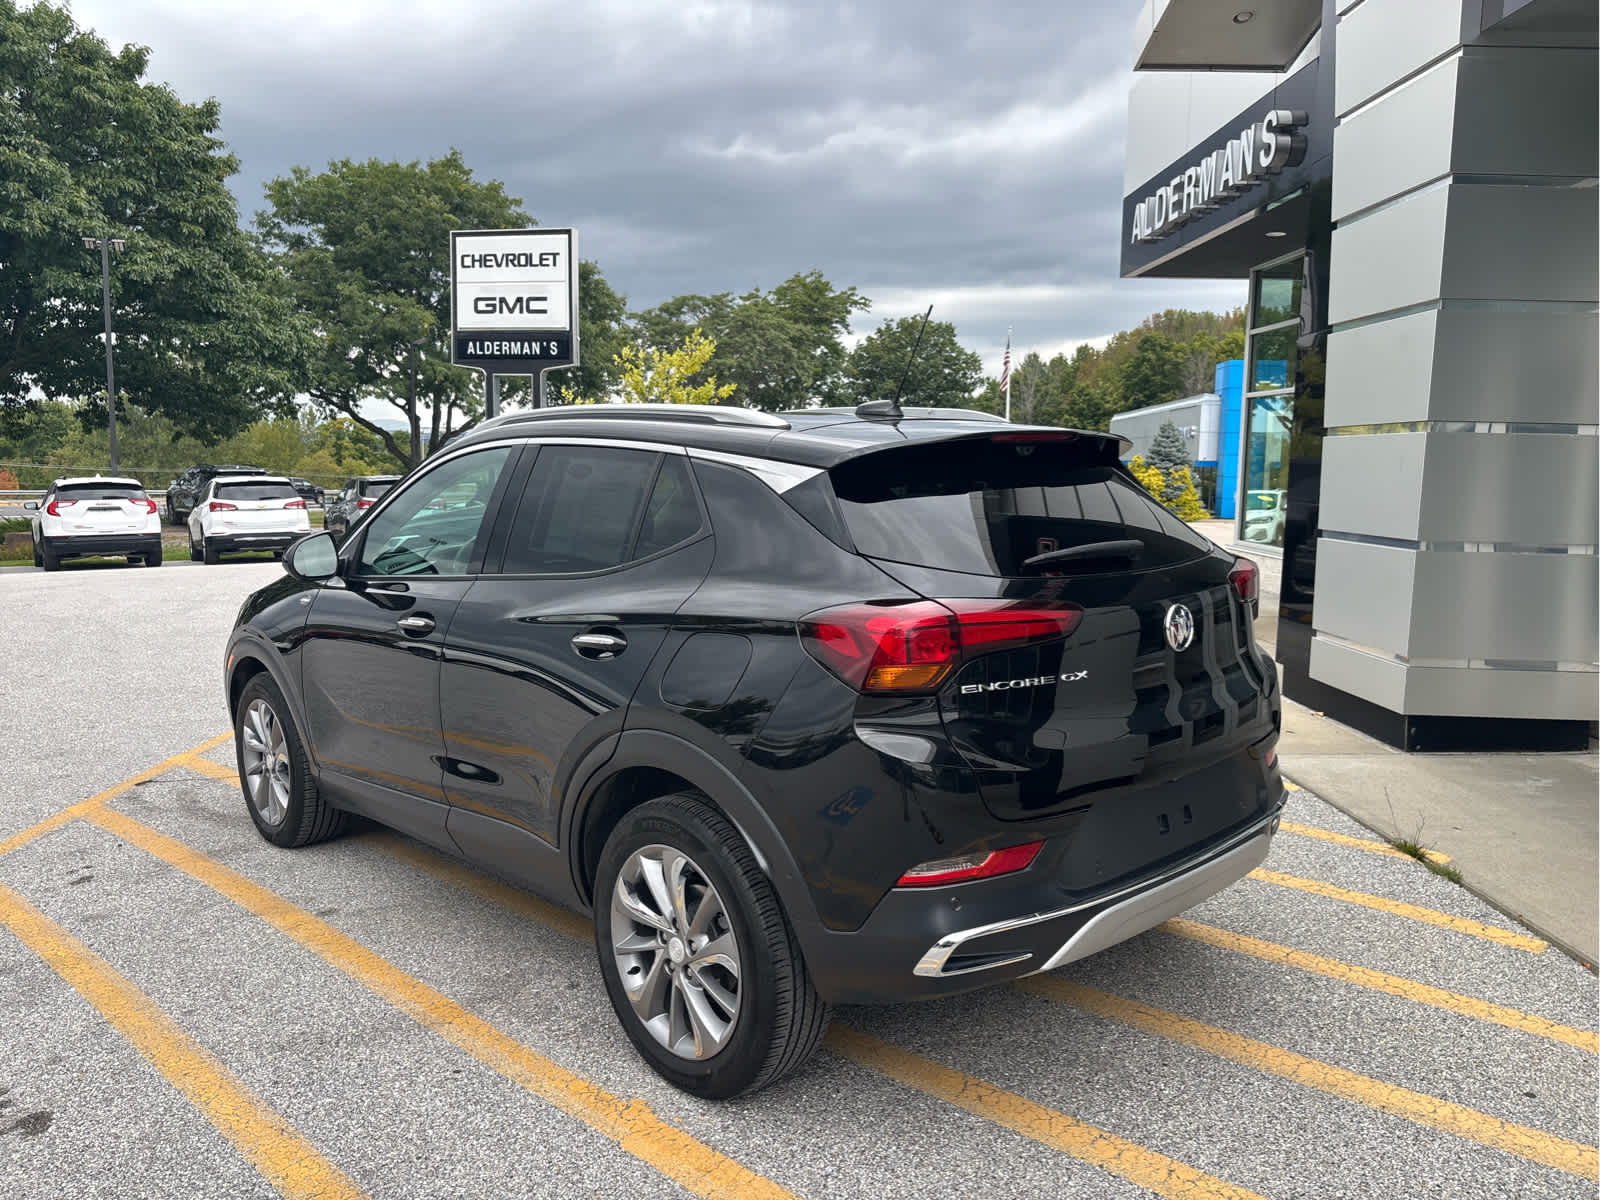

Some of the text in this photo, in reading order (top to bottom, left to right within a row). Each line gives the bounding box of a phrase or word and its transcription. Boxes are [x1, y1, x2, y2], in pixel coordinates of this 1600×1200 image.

[460, 252, 560, 269] CHEVROLET
[473, 296, 548, 315] GMC
[467, 341, 558, 355] ALDERMAN'S
[960, 669, 1088, 695] ENCORE GX
